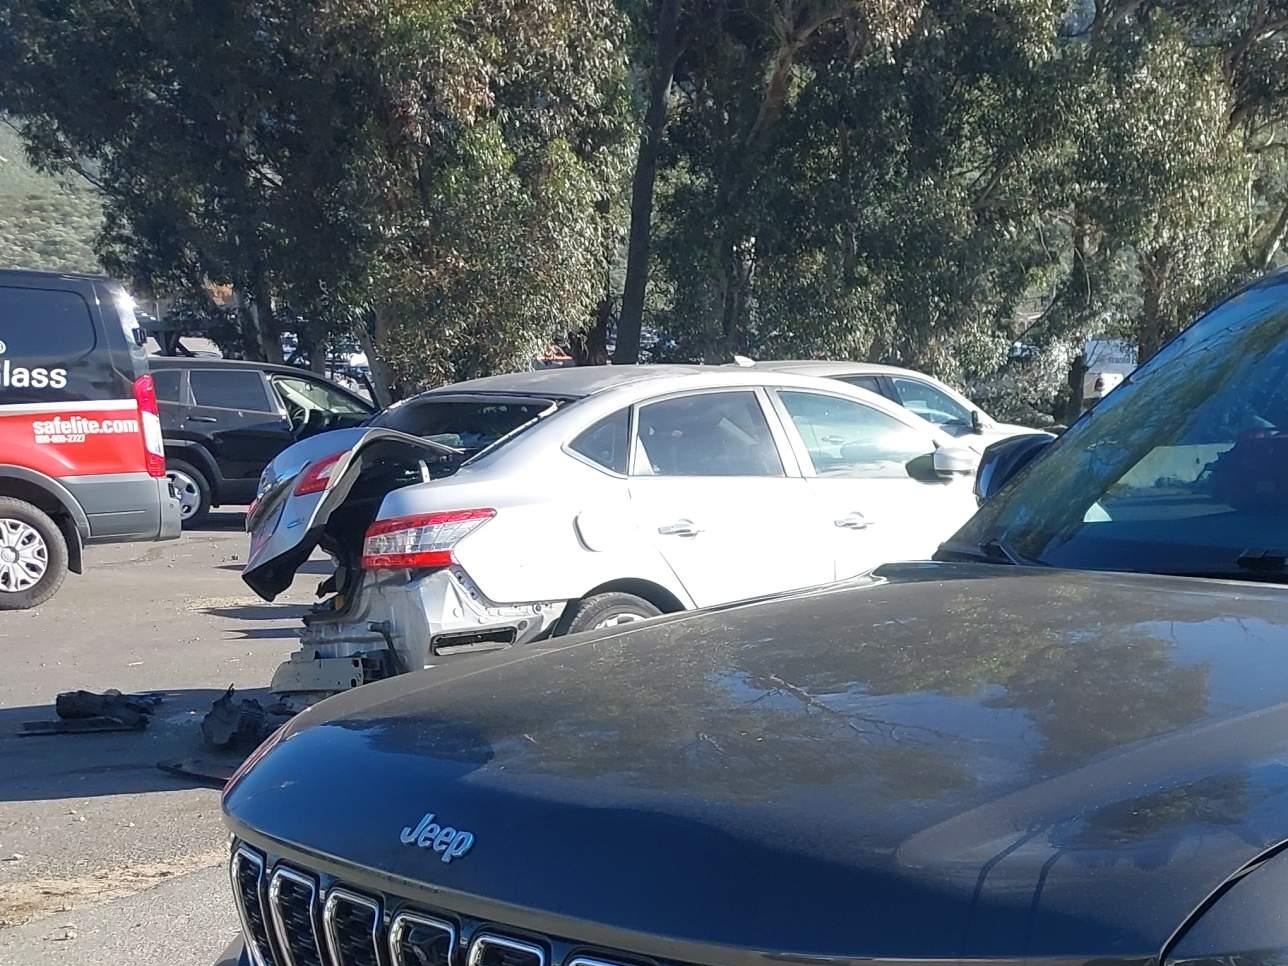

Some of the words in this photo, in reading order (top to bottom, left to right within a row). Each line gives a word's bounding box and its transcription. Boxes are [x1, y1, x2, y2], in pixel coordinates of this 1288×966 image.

[0, 360, 67, 388] lass
[32, 416, 139, 434] safelite.com
[400, 813, 474, 863] Jeep
